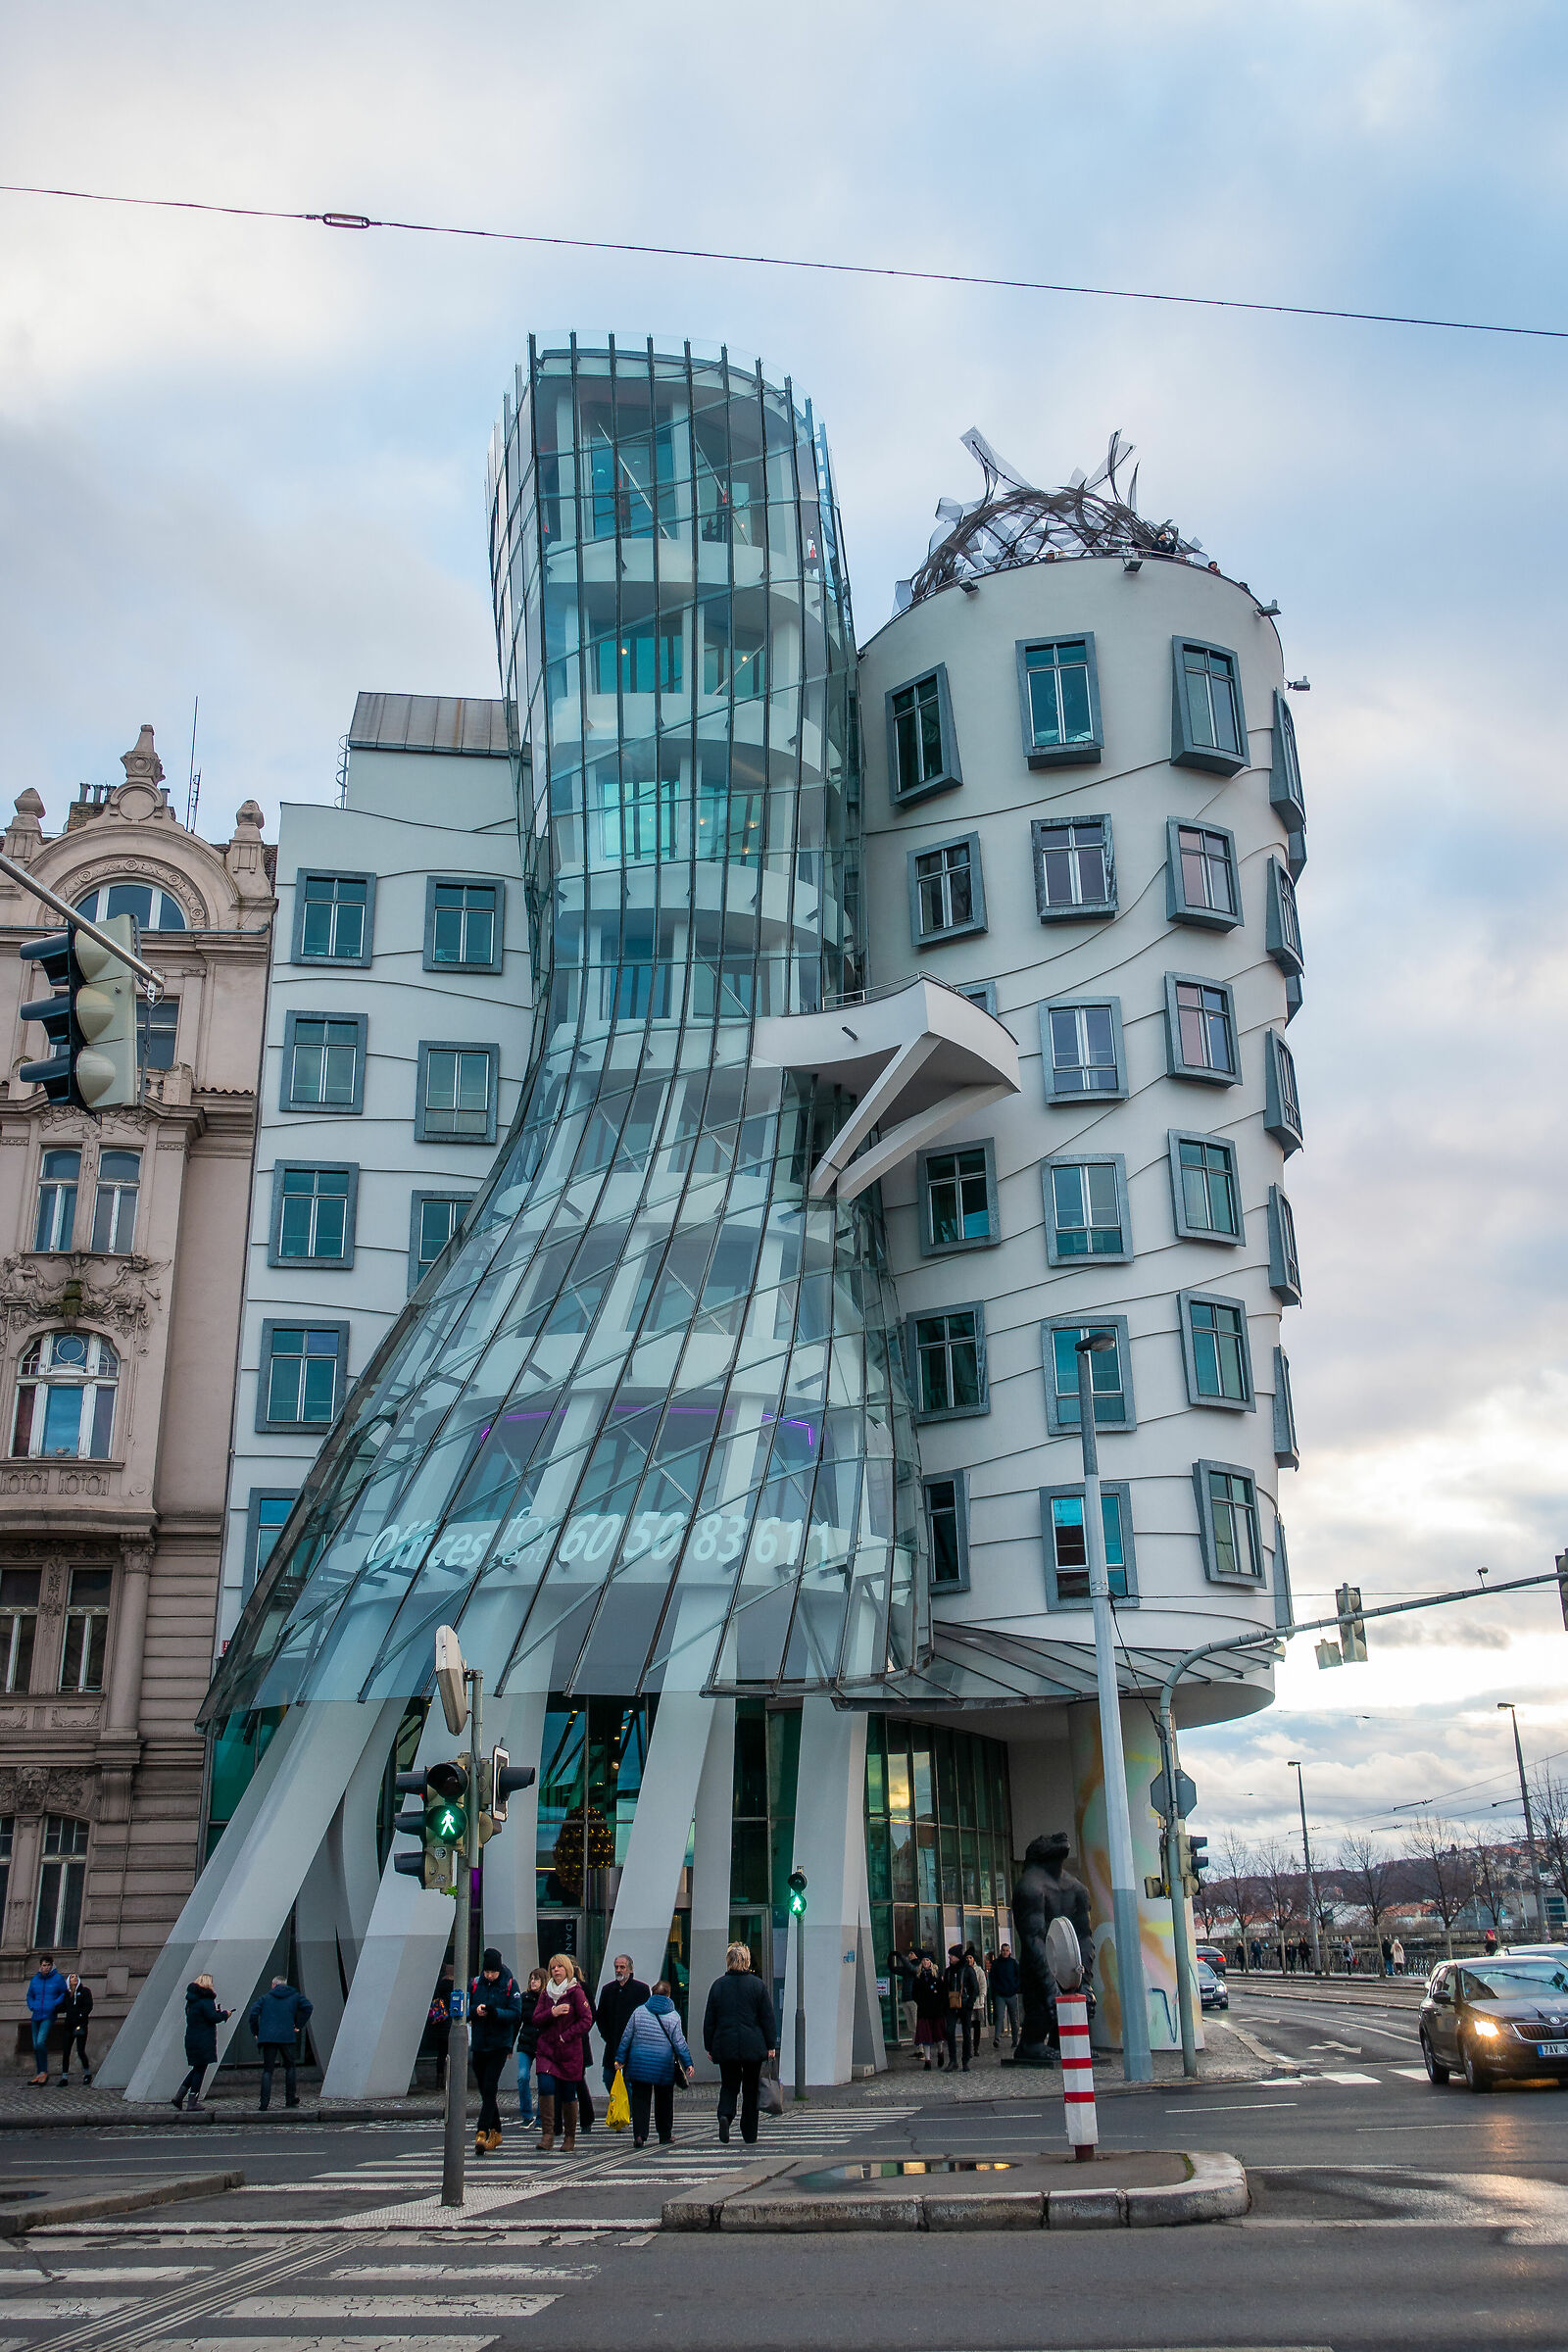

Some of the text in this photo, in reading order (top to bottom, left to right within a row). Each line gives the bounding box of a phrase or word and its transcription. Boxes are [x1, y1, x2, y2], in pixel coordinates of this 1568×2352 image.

[367, 1519, 490, 1569] Offices
[559, 1511, 829, 1566] 60 50 83 611
